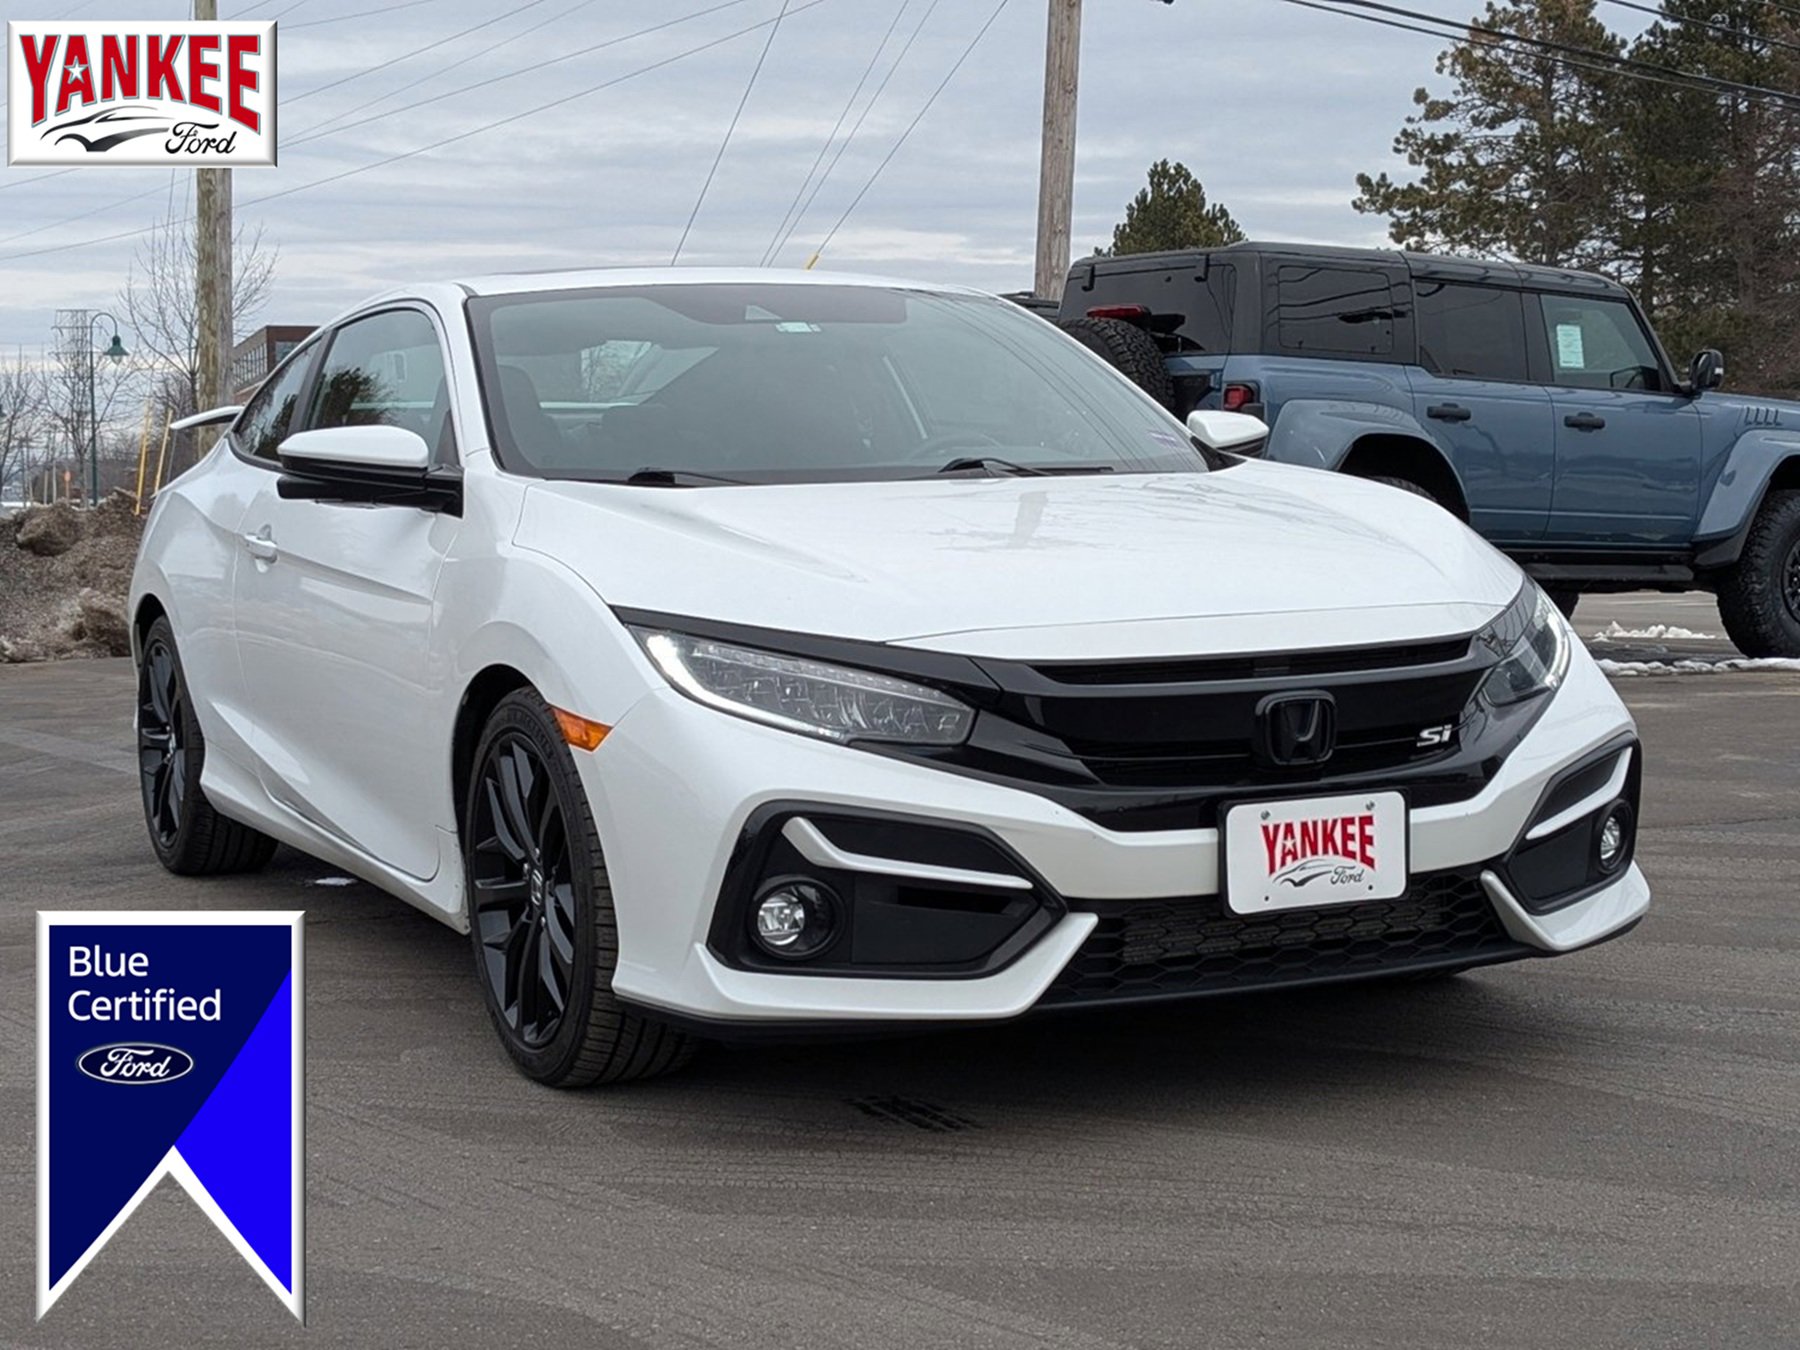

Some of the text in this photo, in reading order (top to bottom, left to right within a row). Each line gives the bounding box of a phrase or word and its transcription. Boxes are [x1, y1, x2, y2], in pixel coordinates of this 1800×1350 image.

[1416, 724, 1452, 747] Si
[1261, 815, 1376, 877] YANKEE
[1330, 865, 1365, 885] Ford
